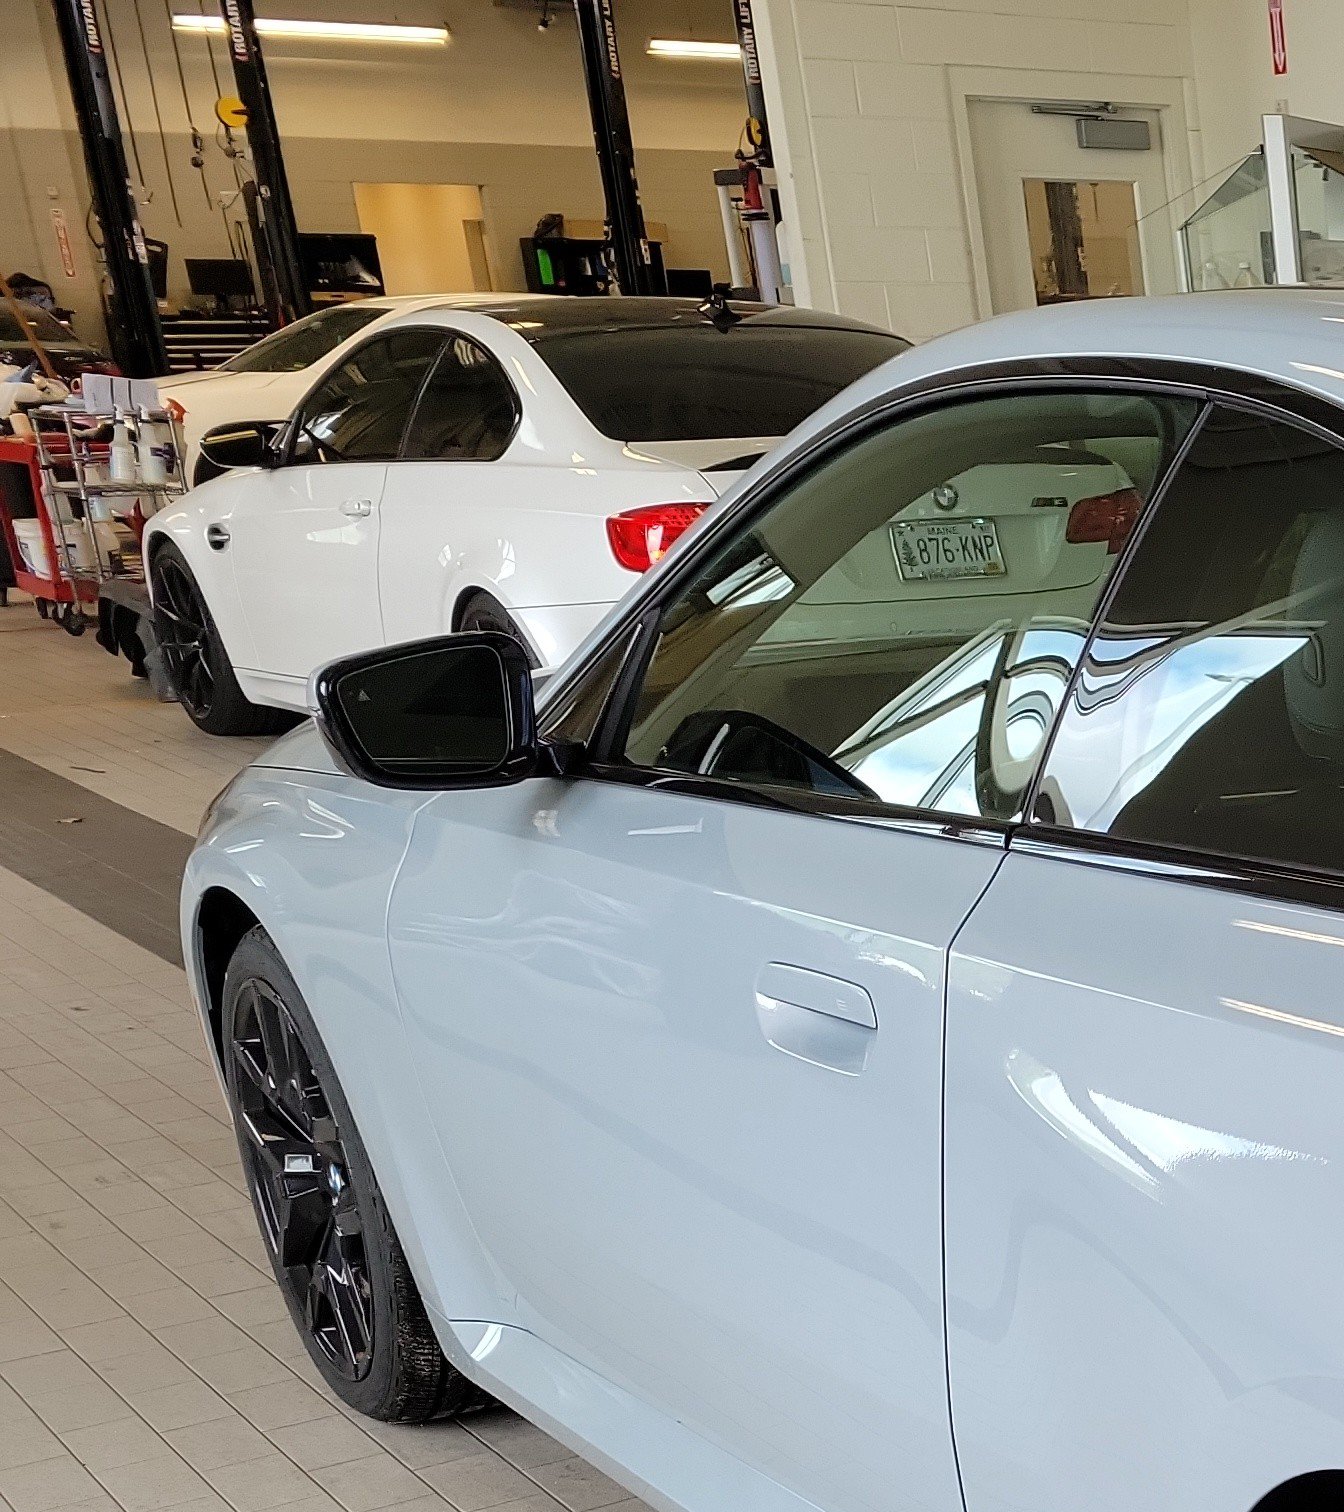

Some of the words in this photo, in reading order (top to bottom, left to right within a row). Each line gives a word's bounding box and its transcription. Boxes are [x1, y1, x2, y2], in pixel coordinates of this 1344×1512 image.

[604, 18, 619, 71] ROTARY
[742, 27, 759, 77] ROTARY
[927, 526, 959, 536] MAINE
